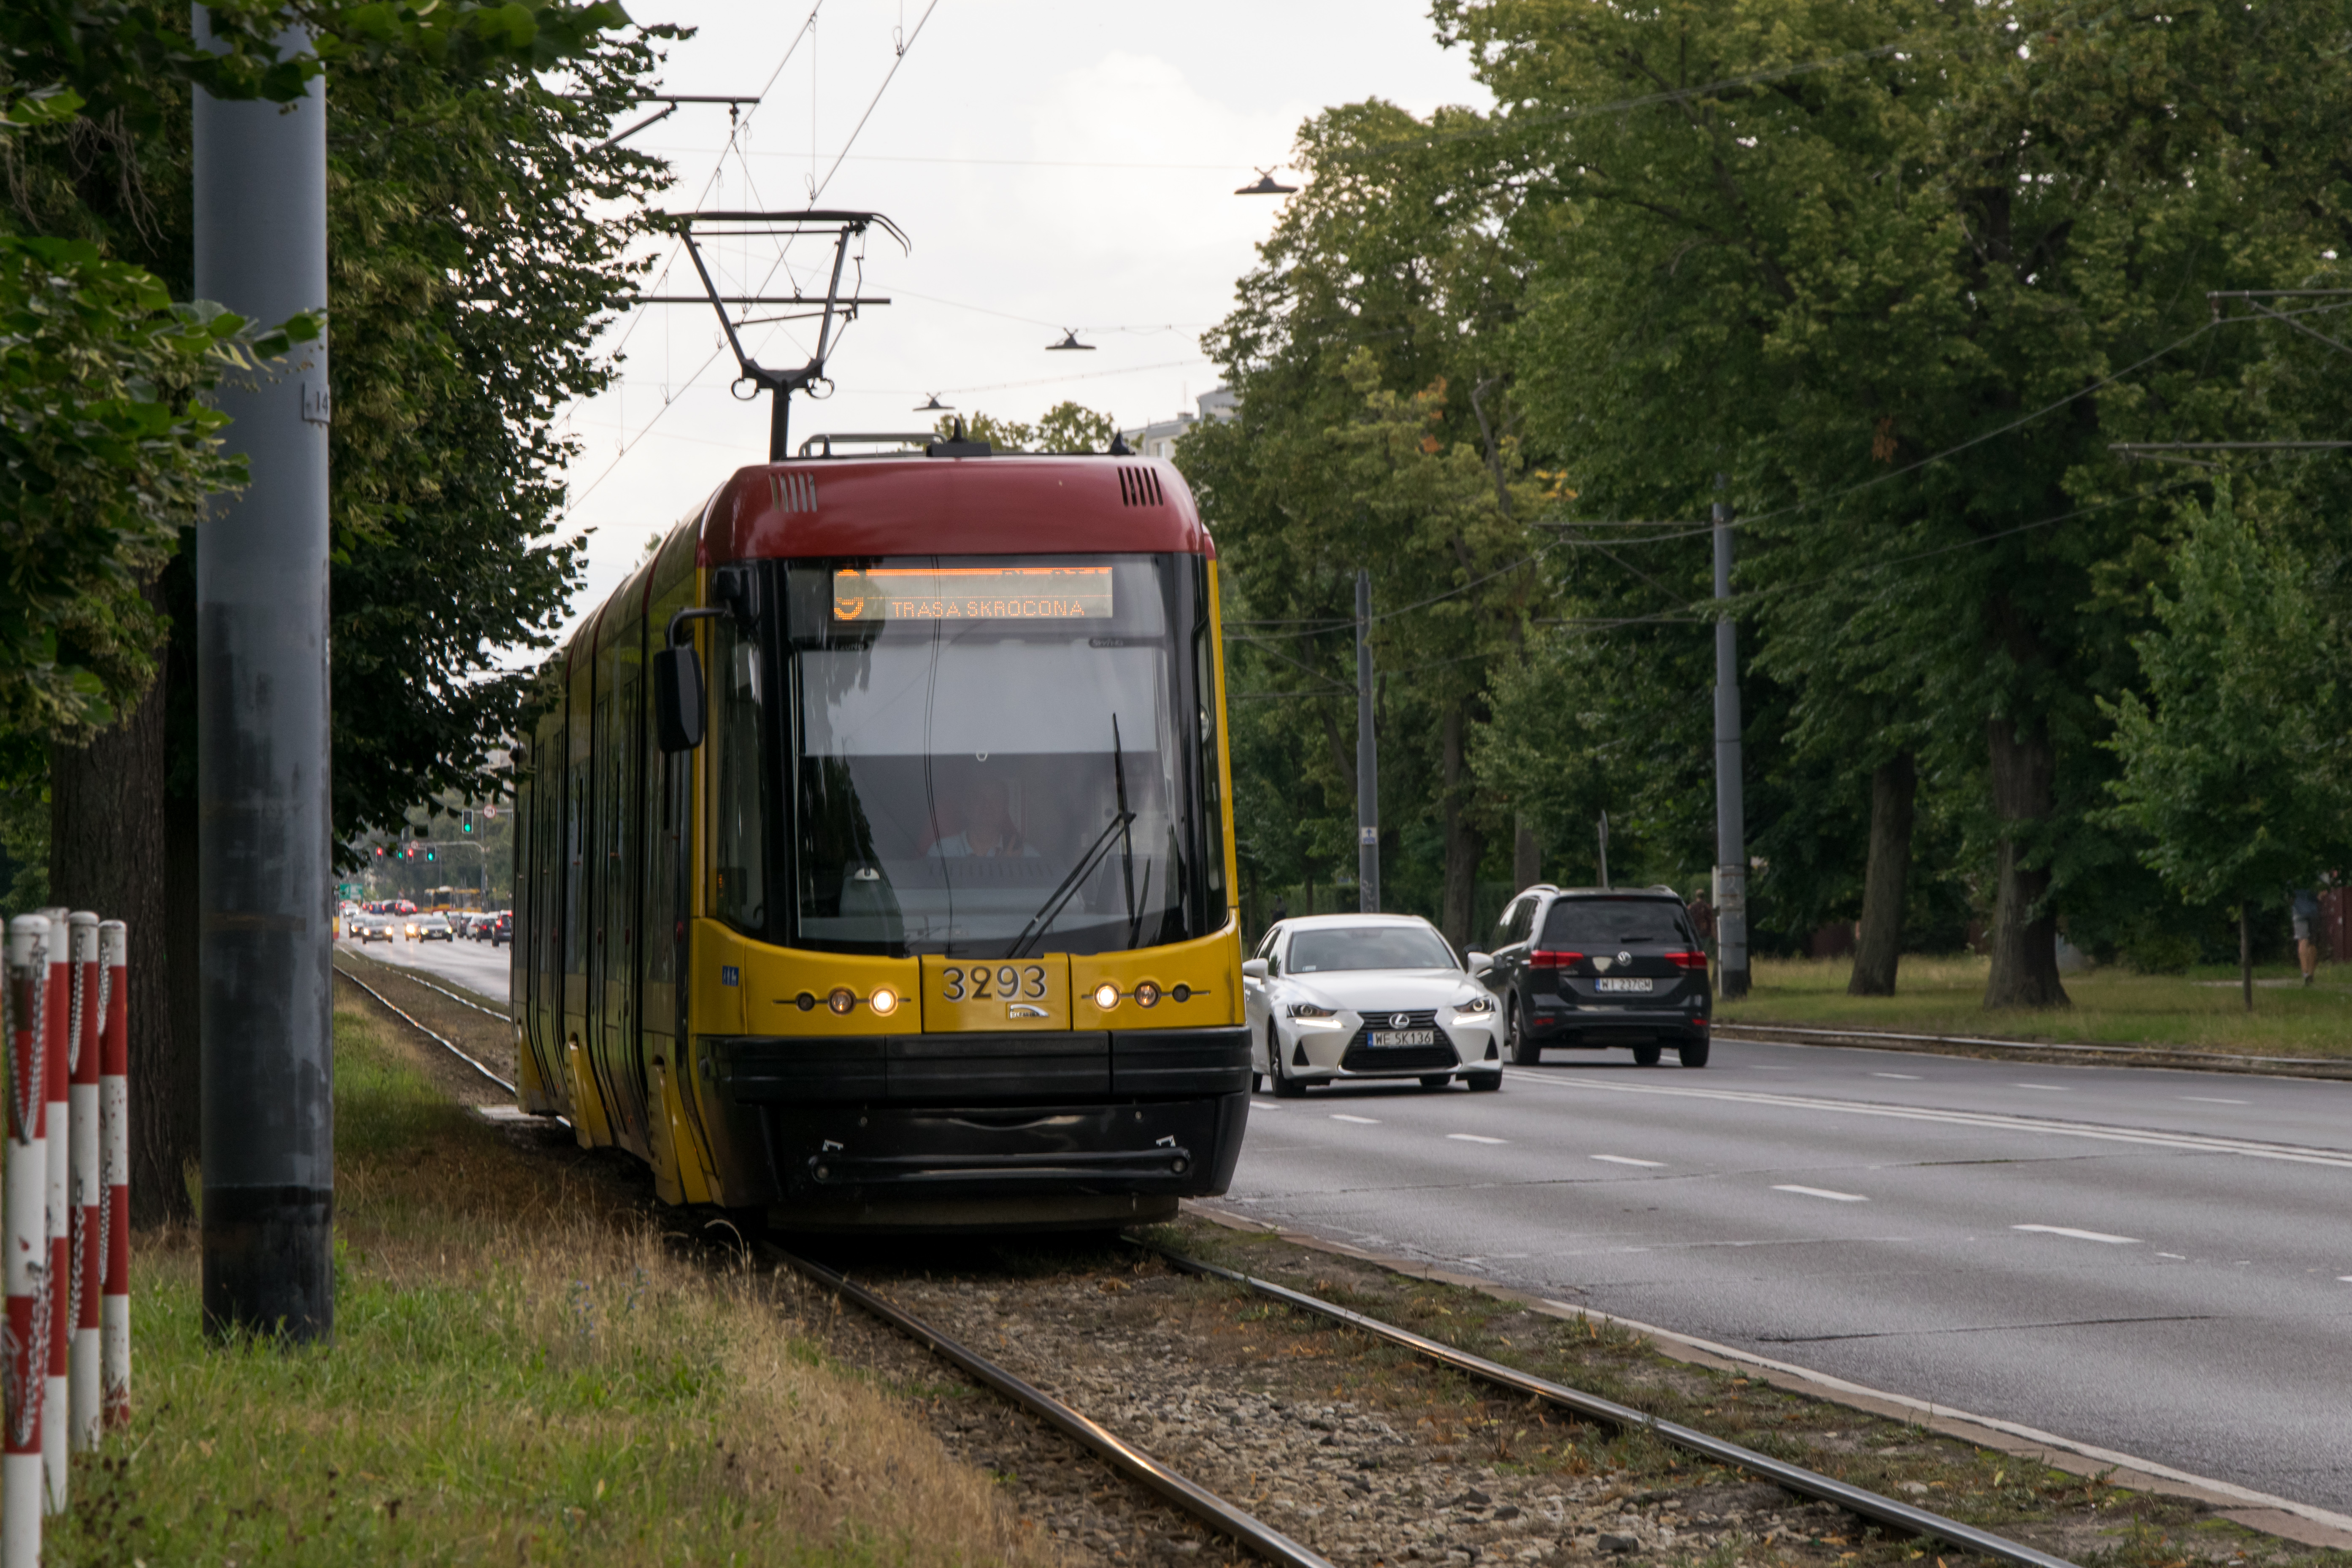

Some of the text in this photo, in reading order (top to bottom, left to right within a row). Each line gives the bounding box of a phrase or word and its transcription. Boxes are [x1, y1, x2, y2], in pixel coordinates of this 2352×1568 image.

[892, 601, 960, 617] TRASA
[943, 965, 1048, 1003] 3293
[1376, 1033, 1391, 1045] WE
